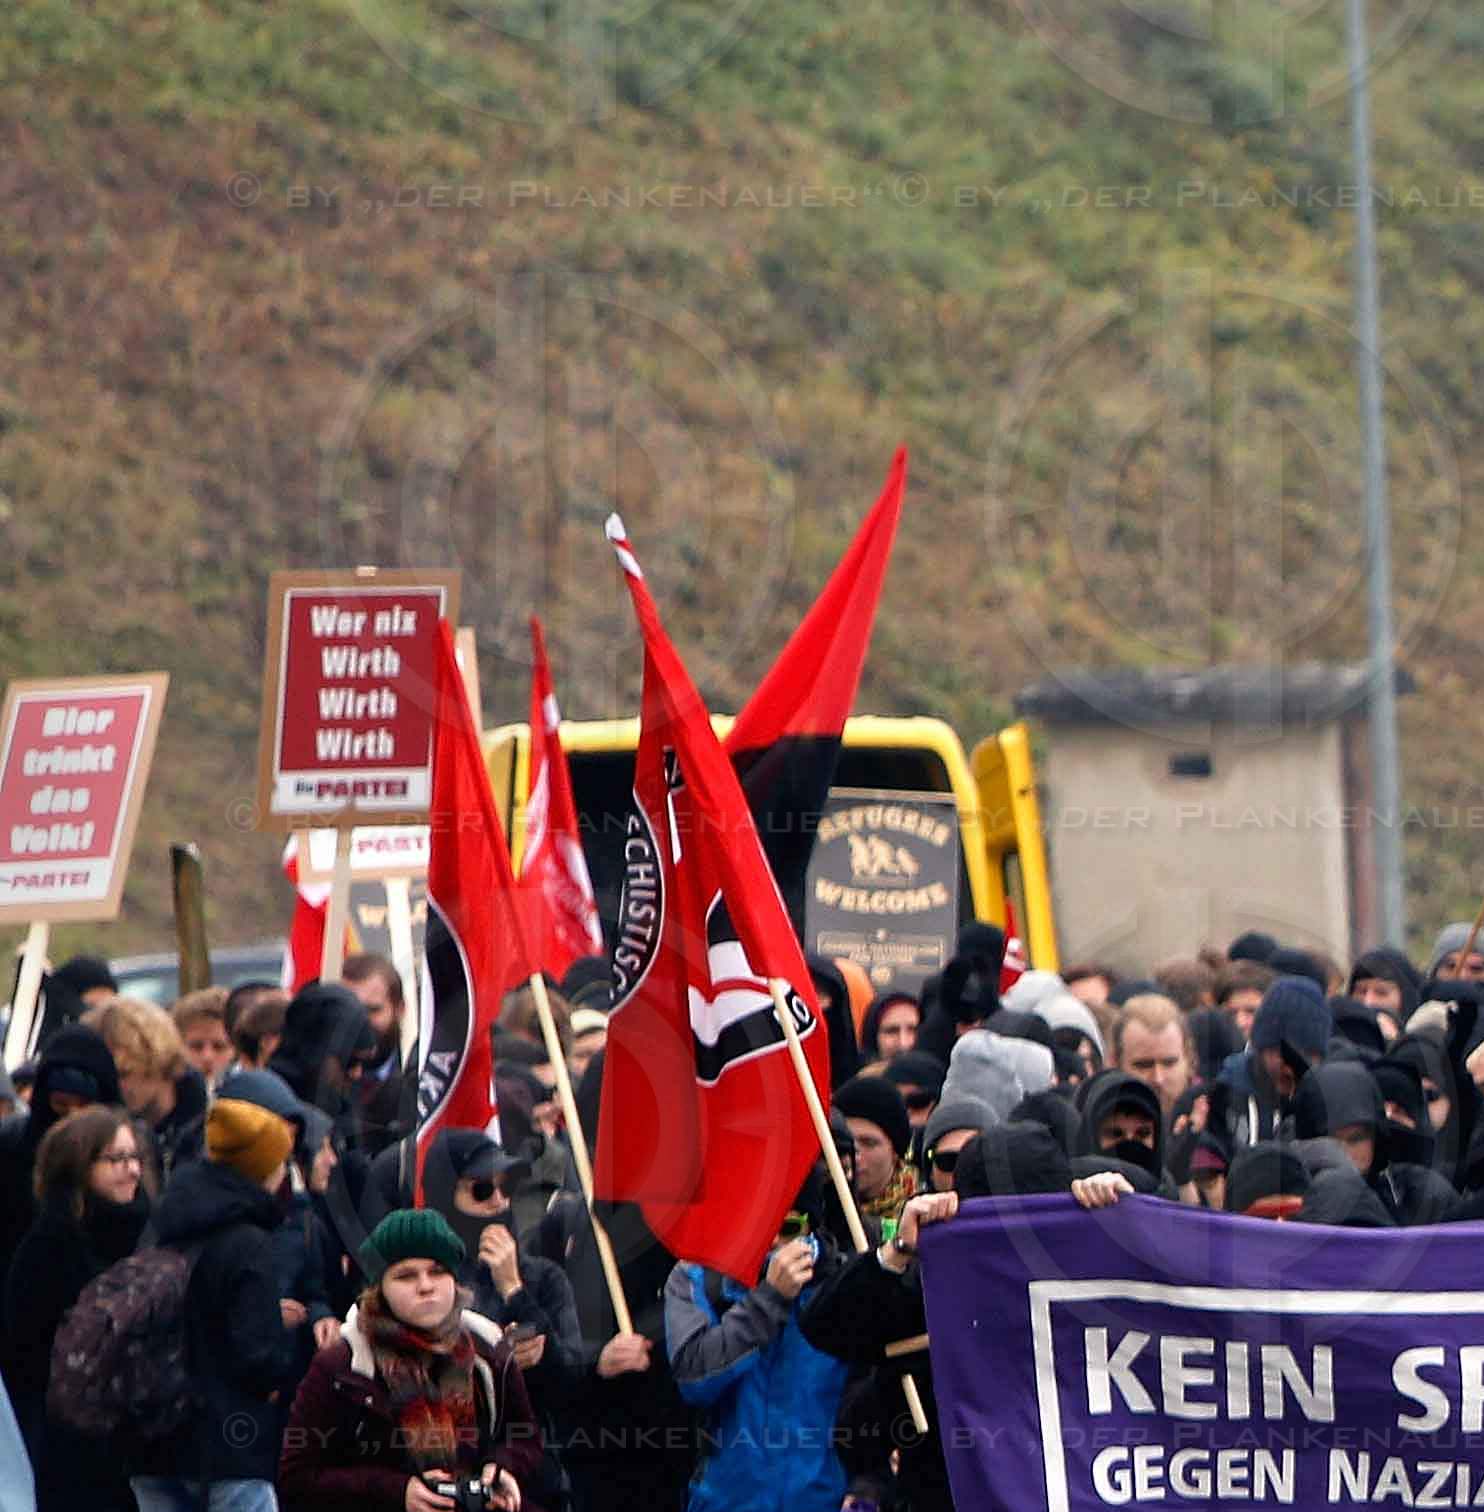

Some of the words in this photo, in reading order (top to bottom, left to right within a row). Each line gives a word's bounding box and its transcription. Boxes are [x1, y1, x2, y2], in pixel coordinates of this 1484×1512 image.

[311, 605, 367, 637] Wer
[374, 604, 417, 636] nix
[321, 646, 400, 679] Wirth
[318, 687, 397, 720] Wirth
[42, 706, 116, 737] Bier
[23, 744, 117, 777] trinkt
[315, 728, 395, 761] Wirth
[30, 784, 90, 815] das
[316, 779, 409, 798] PARTEI
[10, 820, 95, 854] Volk!
[816, 876, 949, 914] WELCOME
[1083, 1326, 1336, 1424] KEIN
[1092, 1444, 1297, 1506] GEGEN
